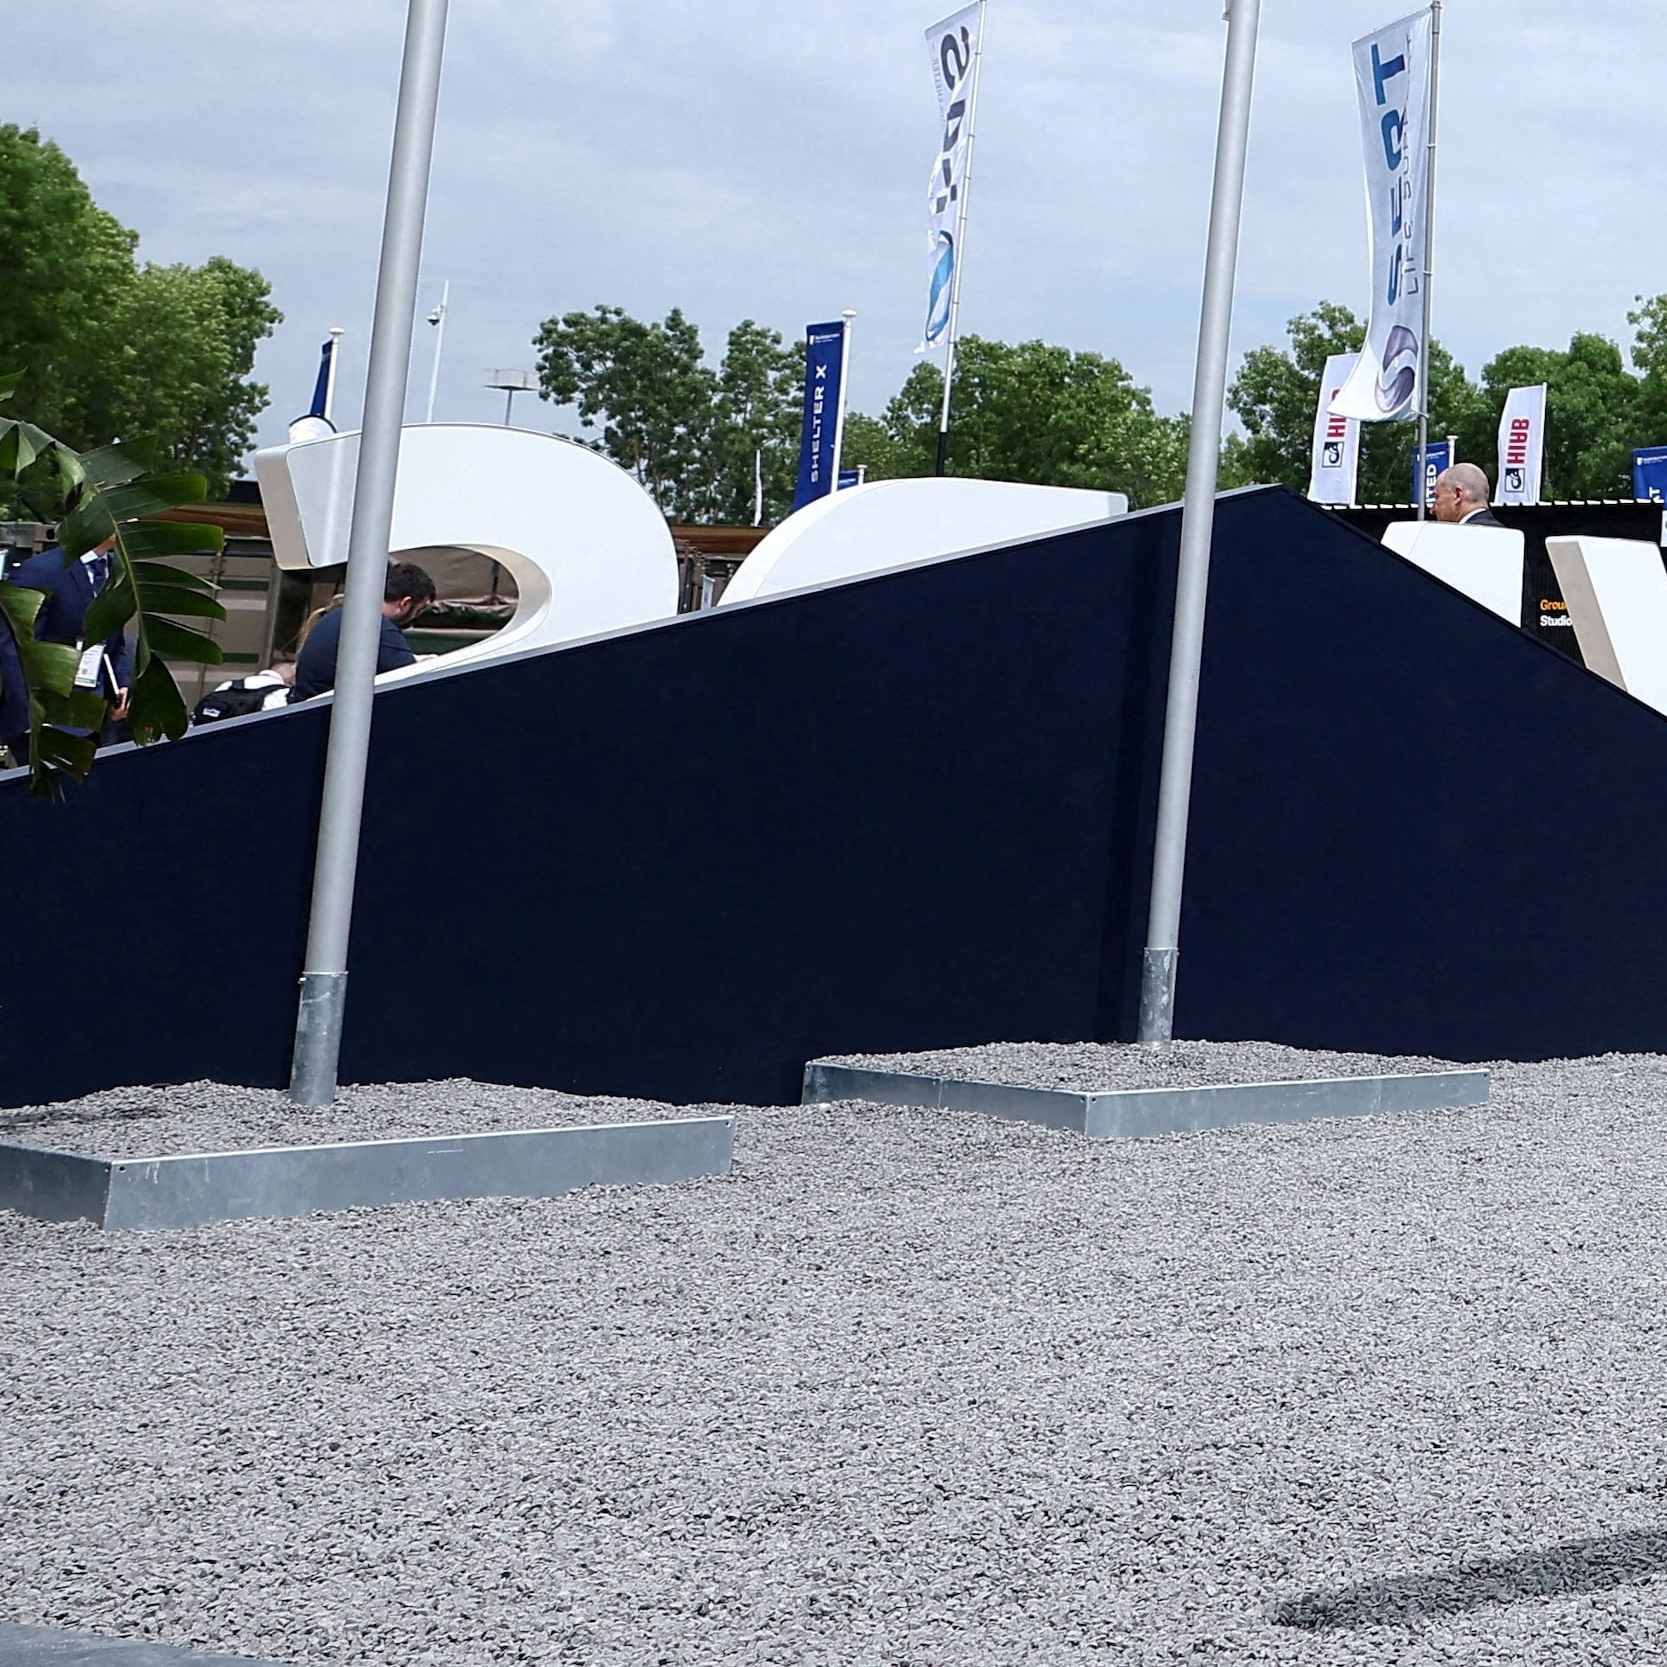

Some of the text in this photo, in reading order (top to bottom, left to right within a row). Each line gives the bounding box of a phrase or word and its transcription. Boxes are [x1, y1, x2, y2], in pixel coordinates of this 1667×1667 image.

[811, 364, 828, 484] SHELTER X
[1425, 464, 1437, 508] ITED
